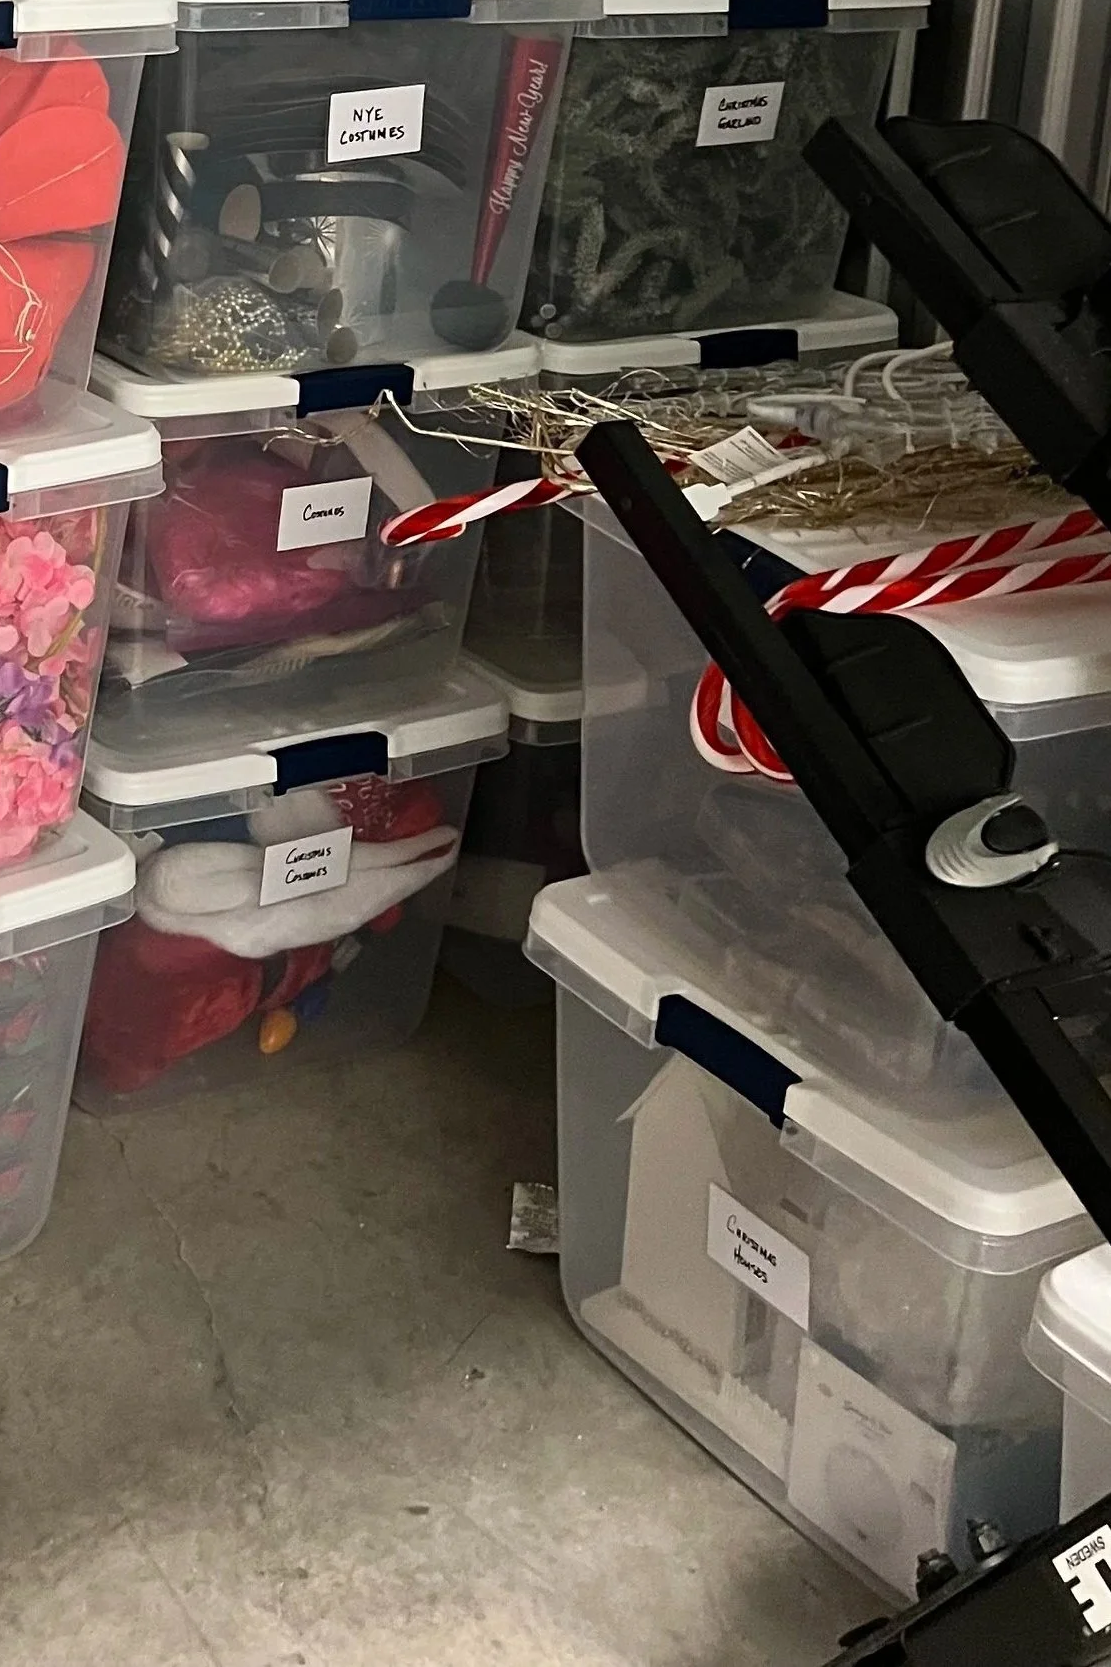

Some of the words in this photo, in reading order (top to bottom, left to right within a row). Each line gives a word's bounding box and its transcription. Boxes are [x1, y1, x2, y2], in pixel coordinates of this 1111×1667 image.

[517, 58, 549, 109] Year!
[353, 108, 385, 122] NYE
[505, 109, 533, 156] New
[489, 158, 525, 215] Happy
[1065, 1536, 1106, 1570] SWEDEN
